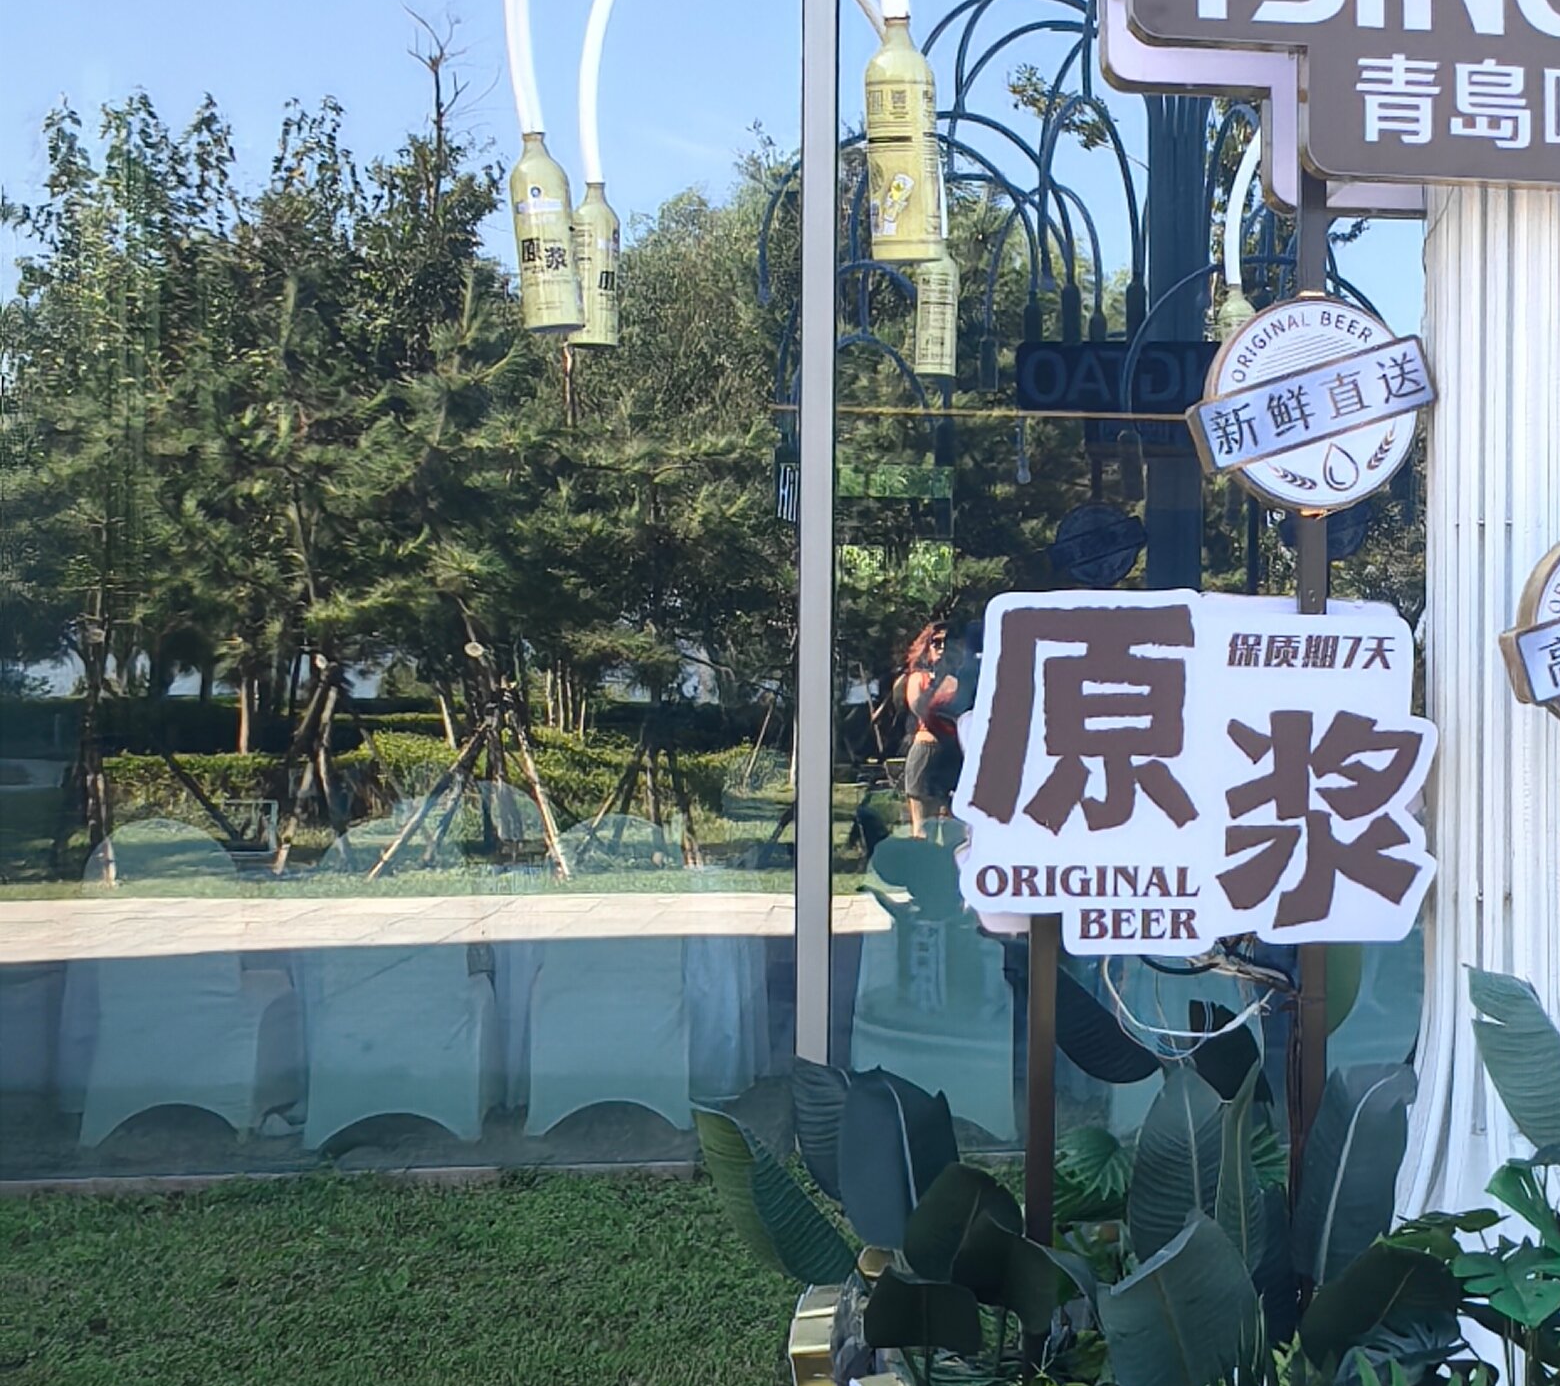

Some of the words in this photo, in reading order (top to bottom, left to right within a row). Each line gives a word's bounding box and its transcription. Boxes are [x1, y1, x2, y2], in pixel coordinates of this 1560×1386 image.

[1231, 311, 1310, 383] ORIGINAL
[1320, 310, 1373, 344] BEER
[1210, 351, 1426, 456] 新鲜直送
[1226, 632, 1396, 670] 保质期7天
[967, 605, 1424, 929] 原浆
[975, 864, 1200, 897] ORIGINAL
[1078, 908, 1200, 940] BEER
